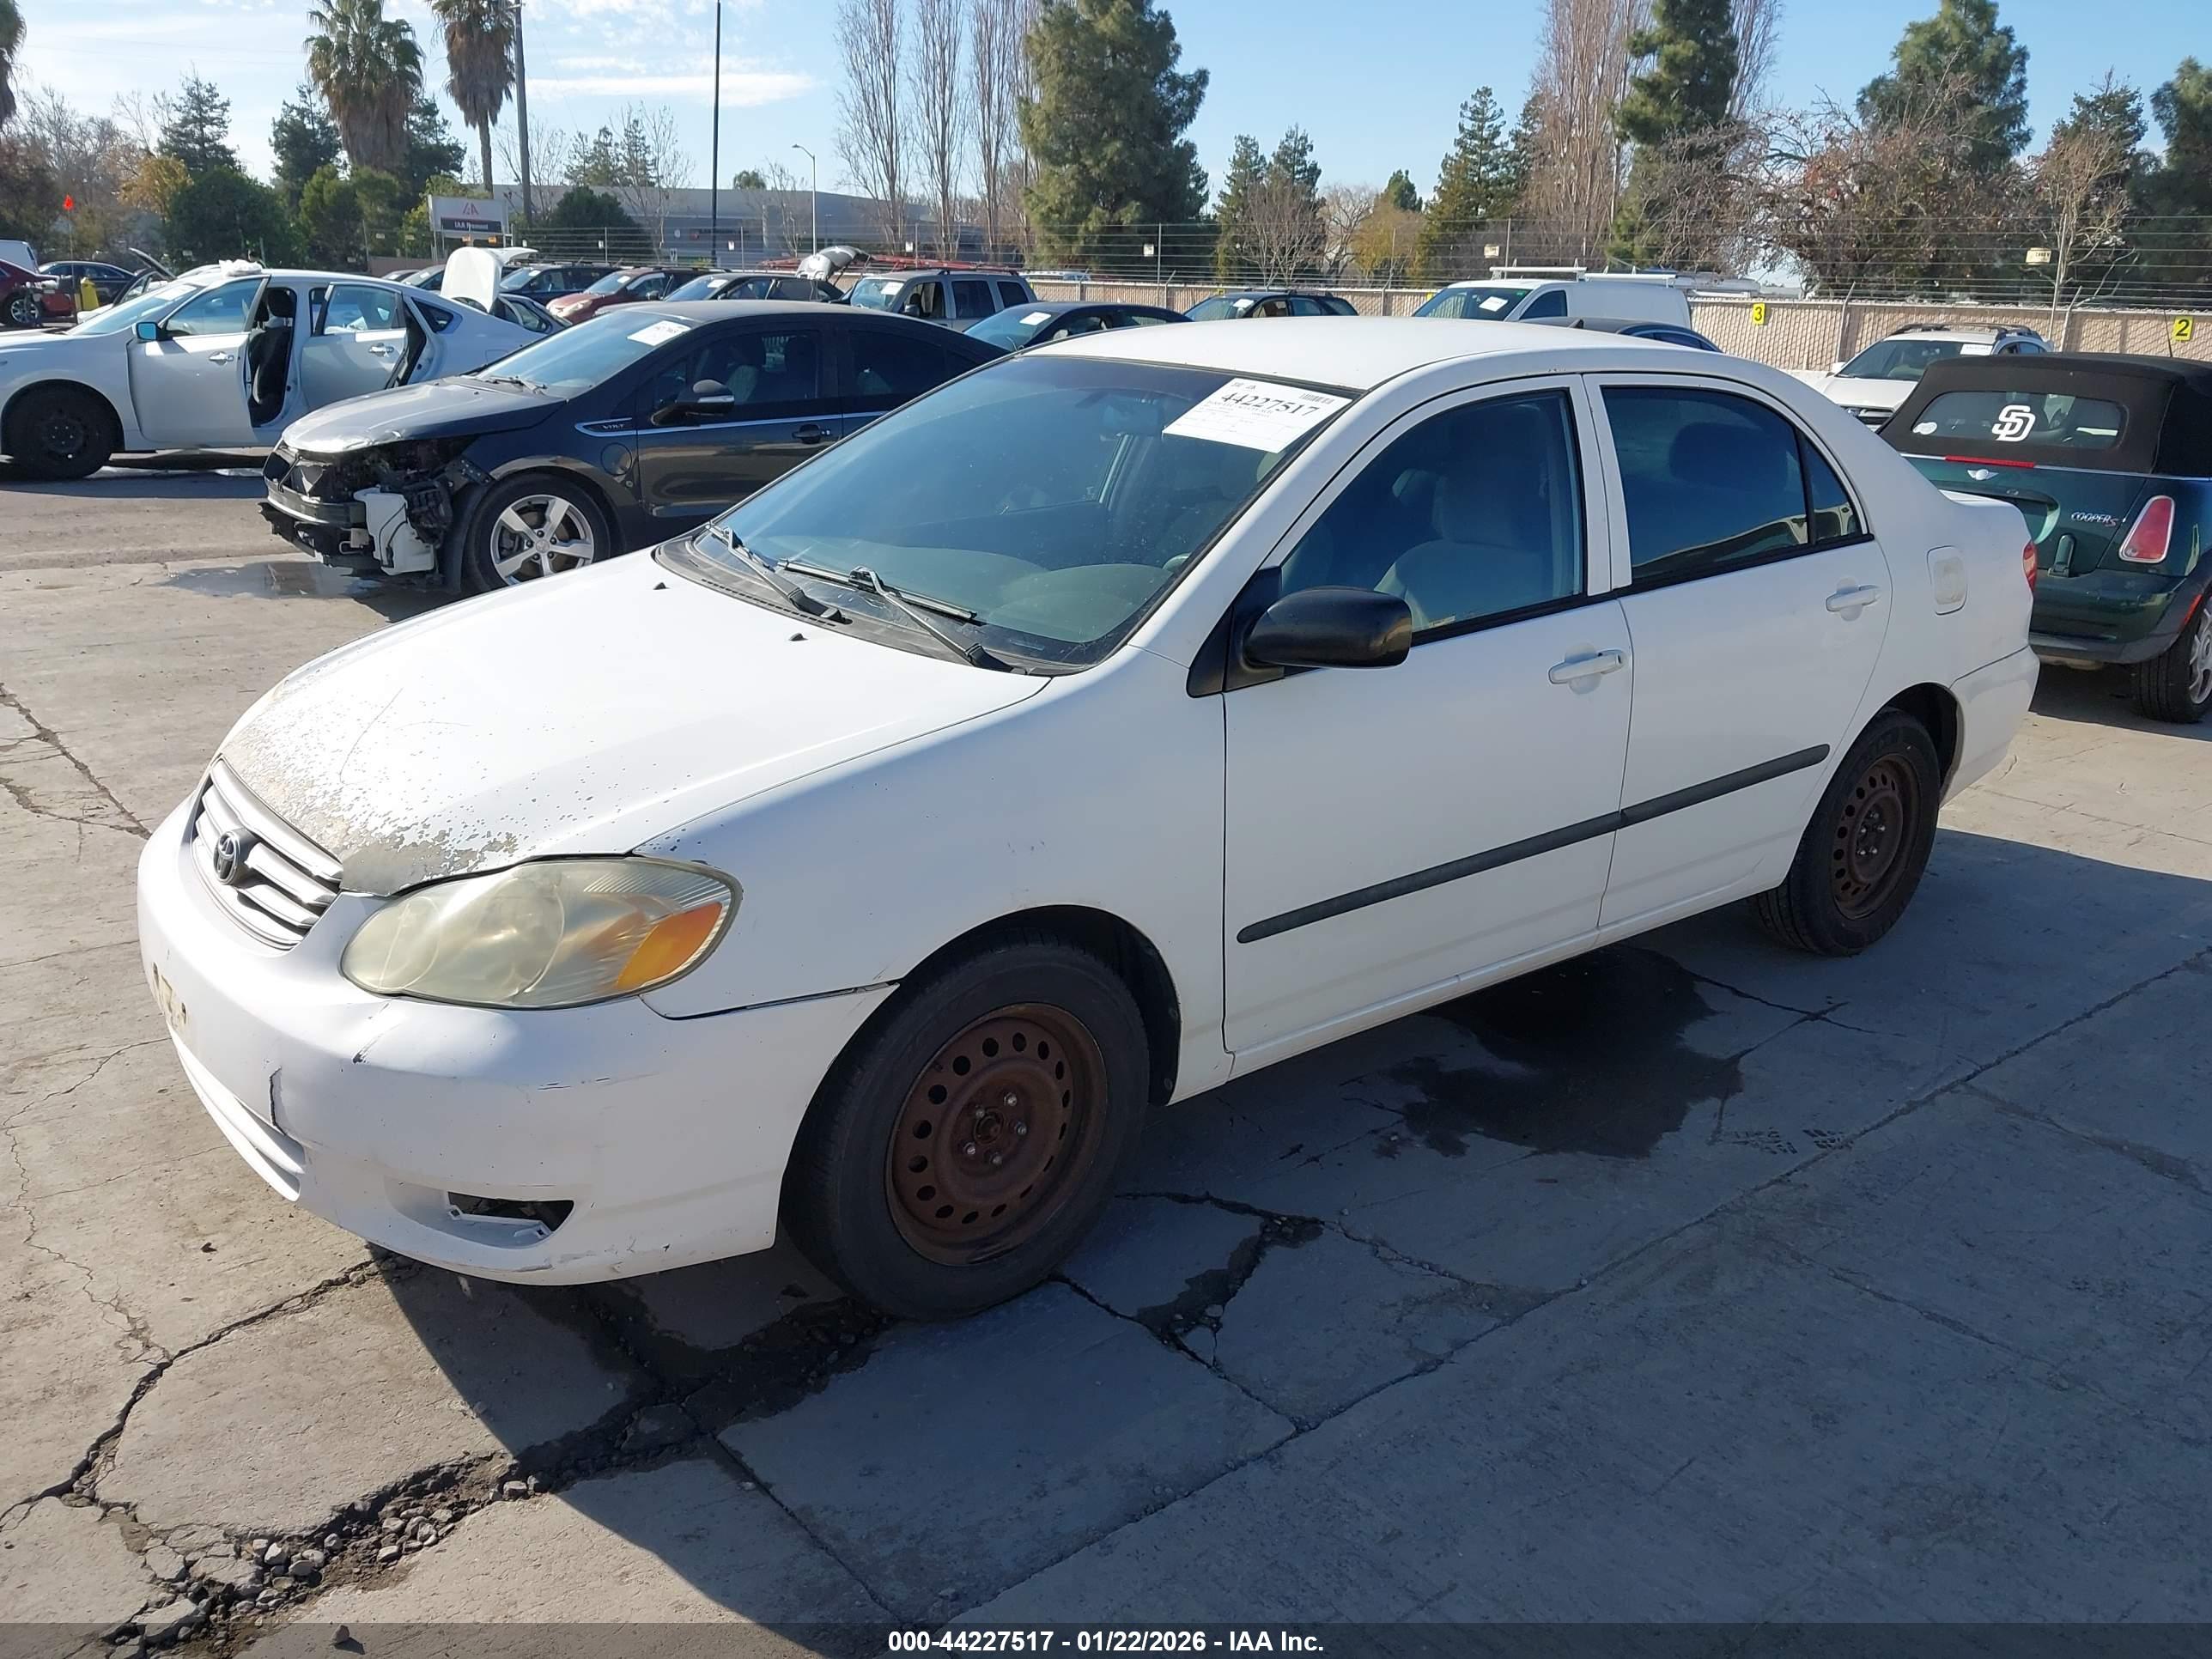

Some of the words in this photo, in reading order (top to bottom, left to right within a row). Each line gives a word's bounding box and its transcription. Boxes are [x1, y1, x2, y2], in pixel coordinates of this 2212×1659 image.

[1754, 307, 1762, 321] 3
[2175, 319, 2190, 337] 2
[1221, 392, 1320, 416] 44227517
